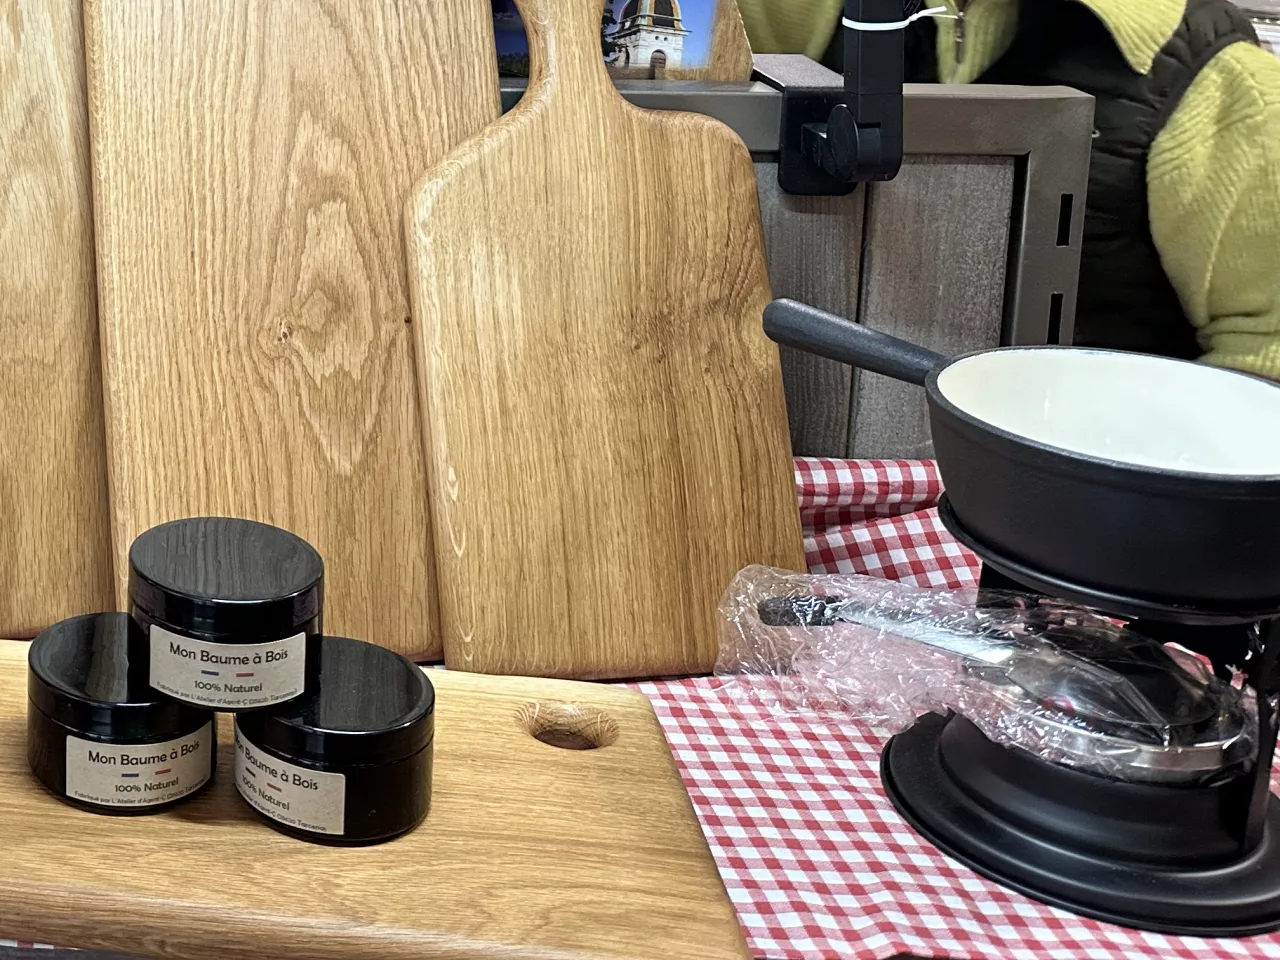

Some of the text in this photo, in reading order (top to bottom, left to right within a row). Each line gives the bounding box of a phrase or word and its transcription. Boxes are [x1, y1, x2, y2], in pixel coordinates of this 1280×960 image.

[170, 642, 289, 665] Mon Baume à Bois
[194, 680, 263, 693] 100% Naturel
[88, 740, 200, 766] Mon Baume à Bois
[244, 747, 278, 778] Baume
[280, 770, 289, 783] à
[292, 774, 319, 791] Bois
[115, 784, 142, 793] 100%
[144, 777, 179, 792] Naturel
[258, 788, 290, 811] Naturel
